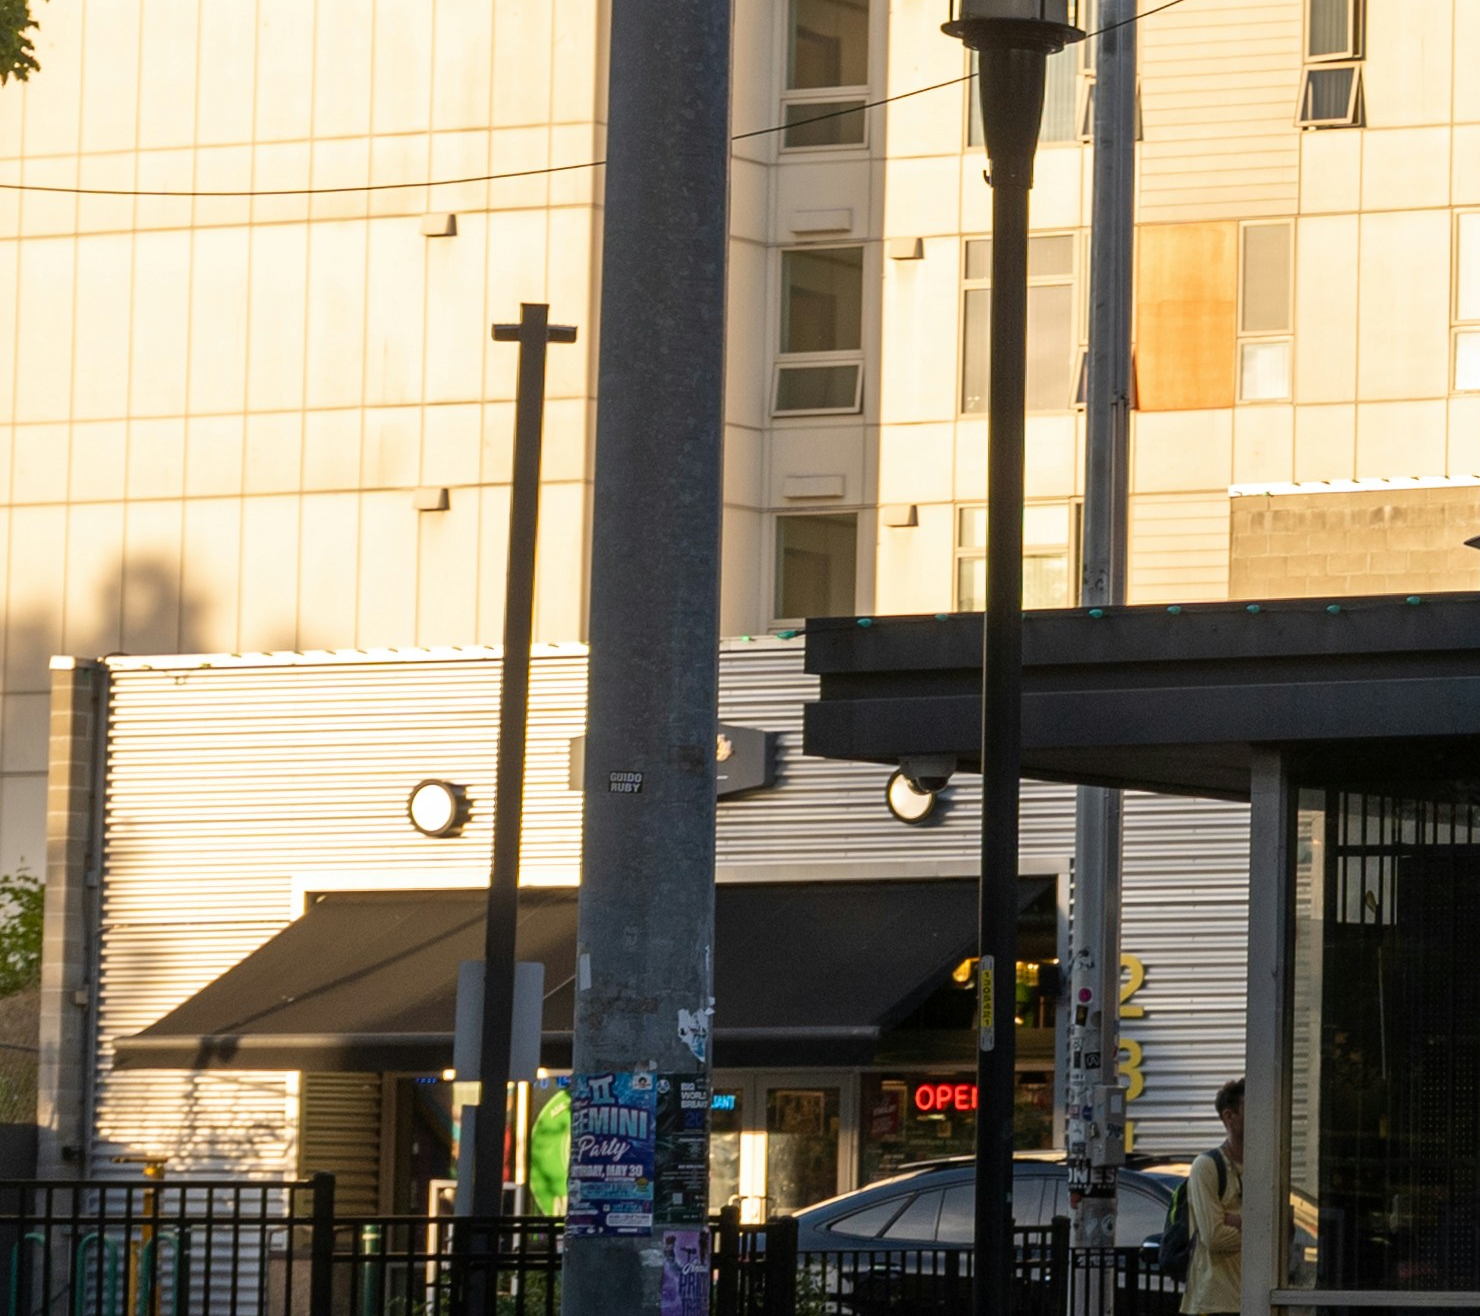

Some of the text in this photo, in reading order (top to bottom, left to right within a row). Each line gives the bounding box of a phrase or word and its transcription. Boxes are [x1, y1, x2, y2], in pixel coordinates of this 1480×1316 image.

[610, 771, 643, 783] GUIDO
[610, 782, 641, 793] RUBY
[577, 1134, 631, 1163] Party
[606, 1164, 628, 1178] MAY
[628, 1164, 643, 1178] 30
